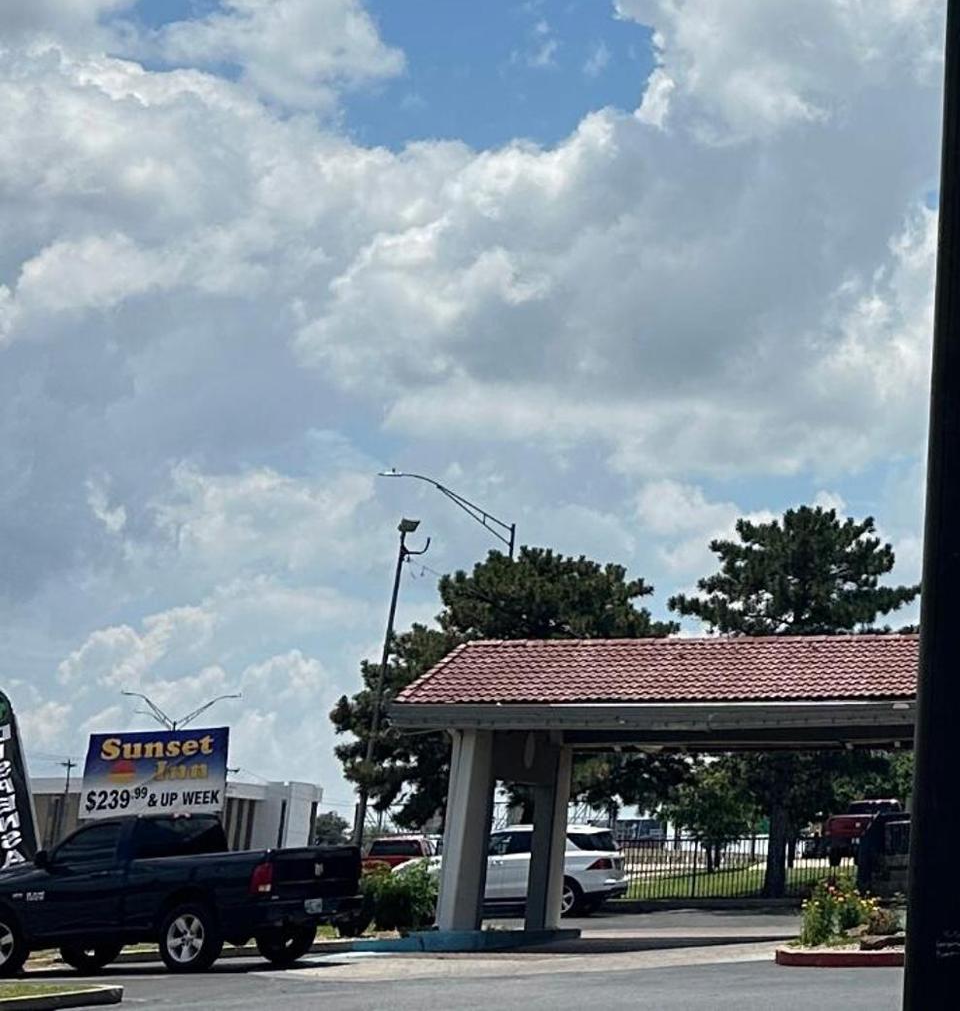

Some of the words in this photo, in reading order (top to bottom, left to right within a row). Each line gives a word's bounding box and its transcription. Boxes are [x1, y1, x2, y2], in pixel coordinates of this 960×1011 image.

[101, 735, 214, 760] Sunset
[154, 760, 208, 781] Inn
[147, 793, 158, 807] &
[160, 792, 178, 806] UP
[182, 790, 220, 805] WEEK
